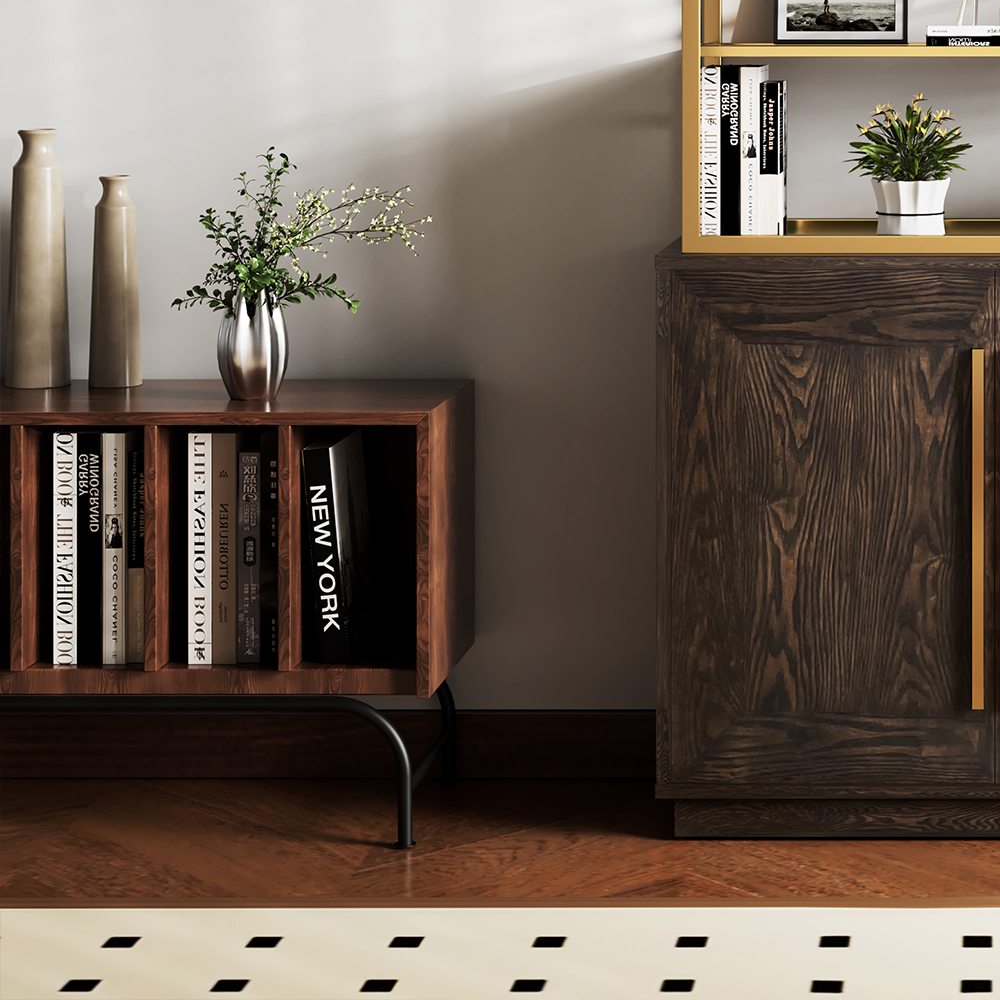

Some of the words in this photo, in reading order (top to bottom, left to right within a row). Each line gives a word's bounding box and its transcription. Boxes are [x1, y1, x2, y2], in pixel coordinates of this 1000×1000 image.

[767, 98, 775, 125] Jasper
[309, 484, 332, 547] NEW
[316, 553, 341, 633] YORK
